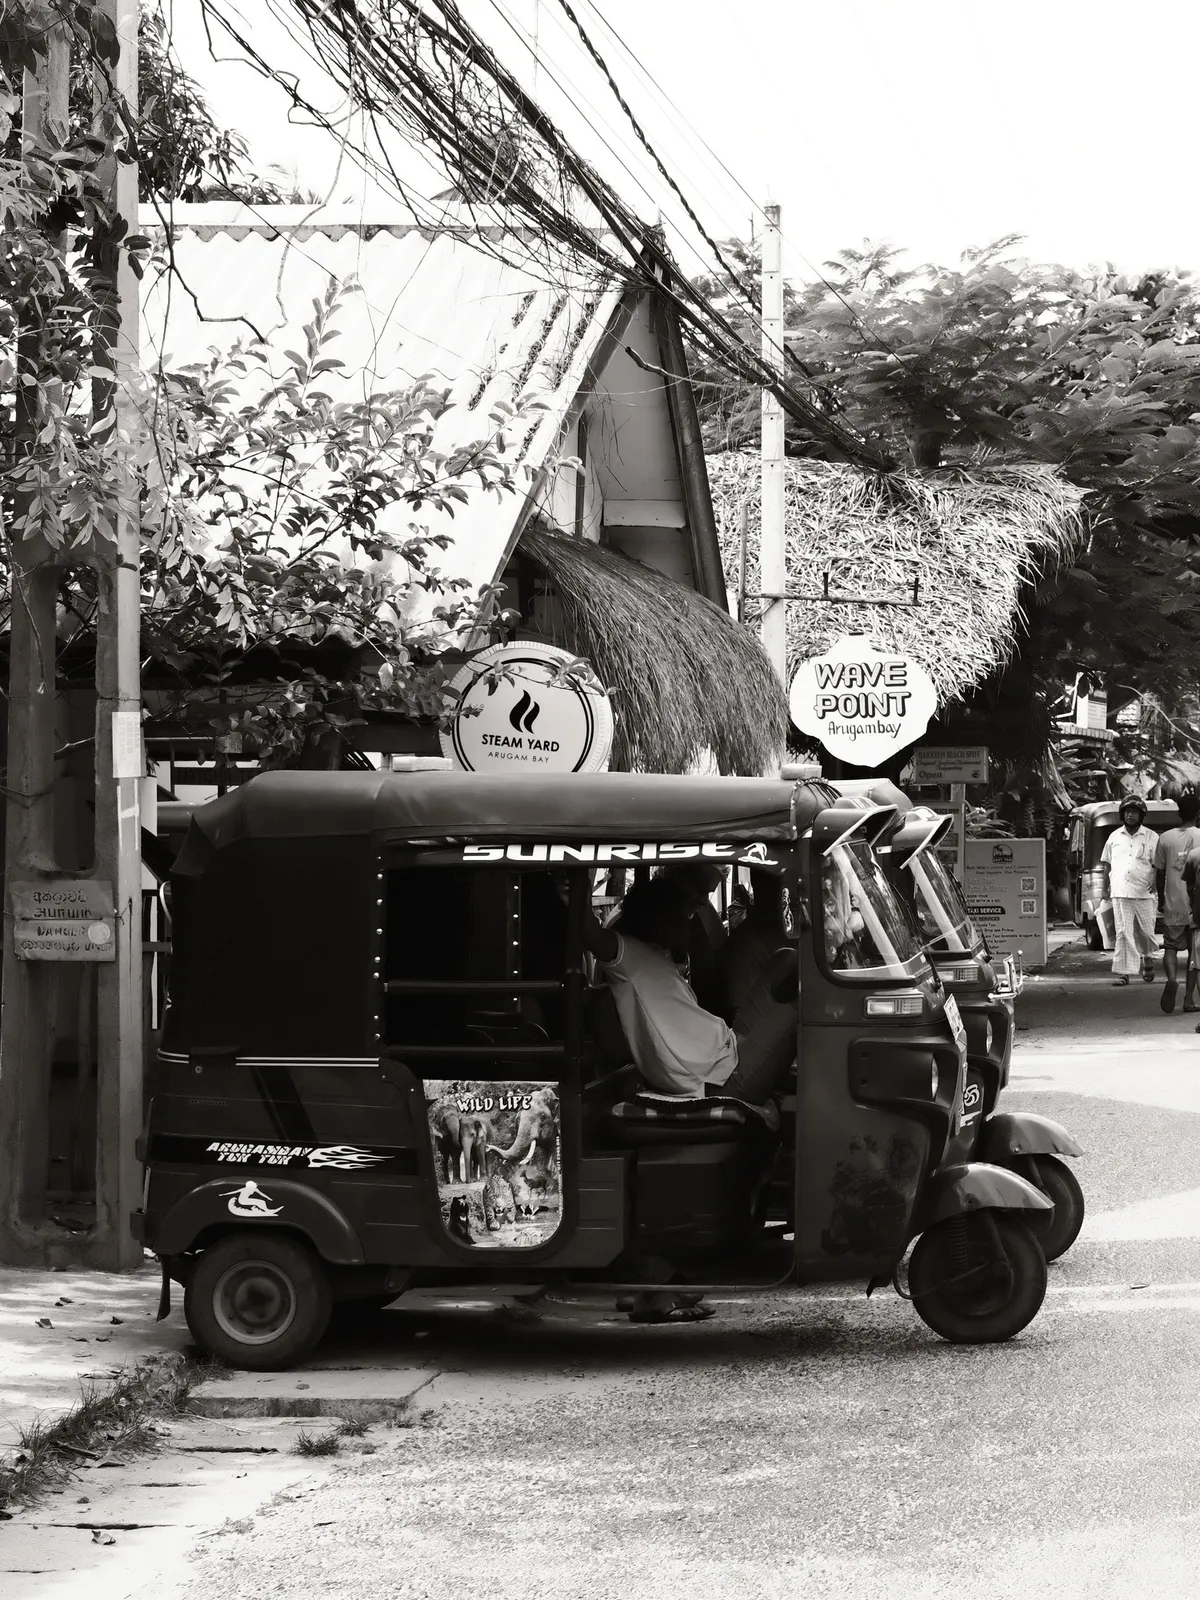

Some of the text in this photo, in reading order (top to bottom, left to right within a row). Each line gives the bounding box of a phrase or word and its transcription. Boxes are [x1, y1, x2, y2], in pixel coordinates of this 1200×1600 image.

[814, 660, 908, 689] WAVE
[813, 691, 912, 719] POINT
[828, 719, 902, 741] Arugambay
[481, 733, 560, 752] STEAM YARD
[487, 751, 550, 764] ARUGAM BAY
[966, 750, 981, 758] SPOT
[918, 770, 943, 779] Open
[462, 842, 737, 861] SUNRISE
[37, 926, 86, 937] DANGER
[456, 1095, 533, 1112] WILD LIFE
[217, 1152, 293, 1165] TUK TUK
